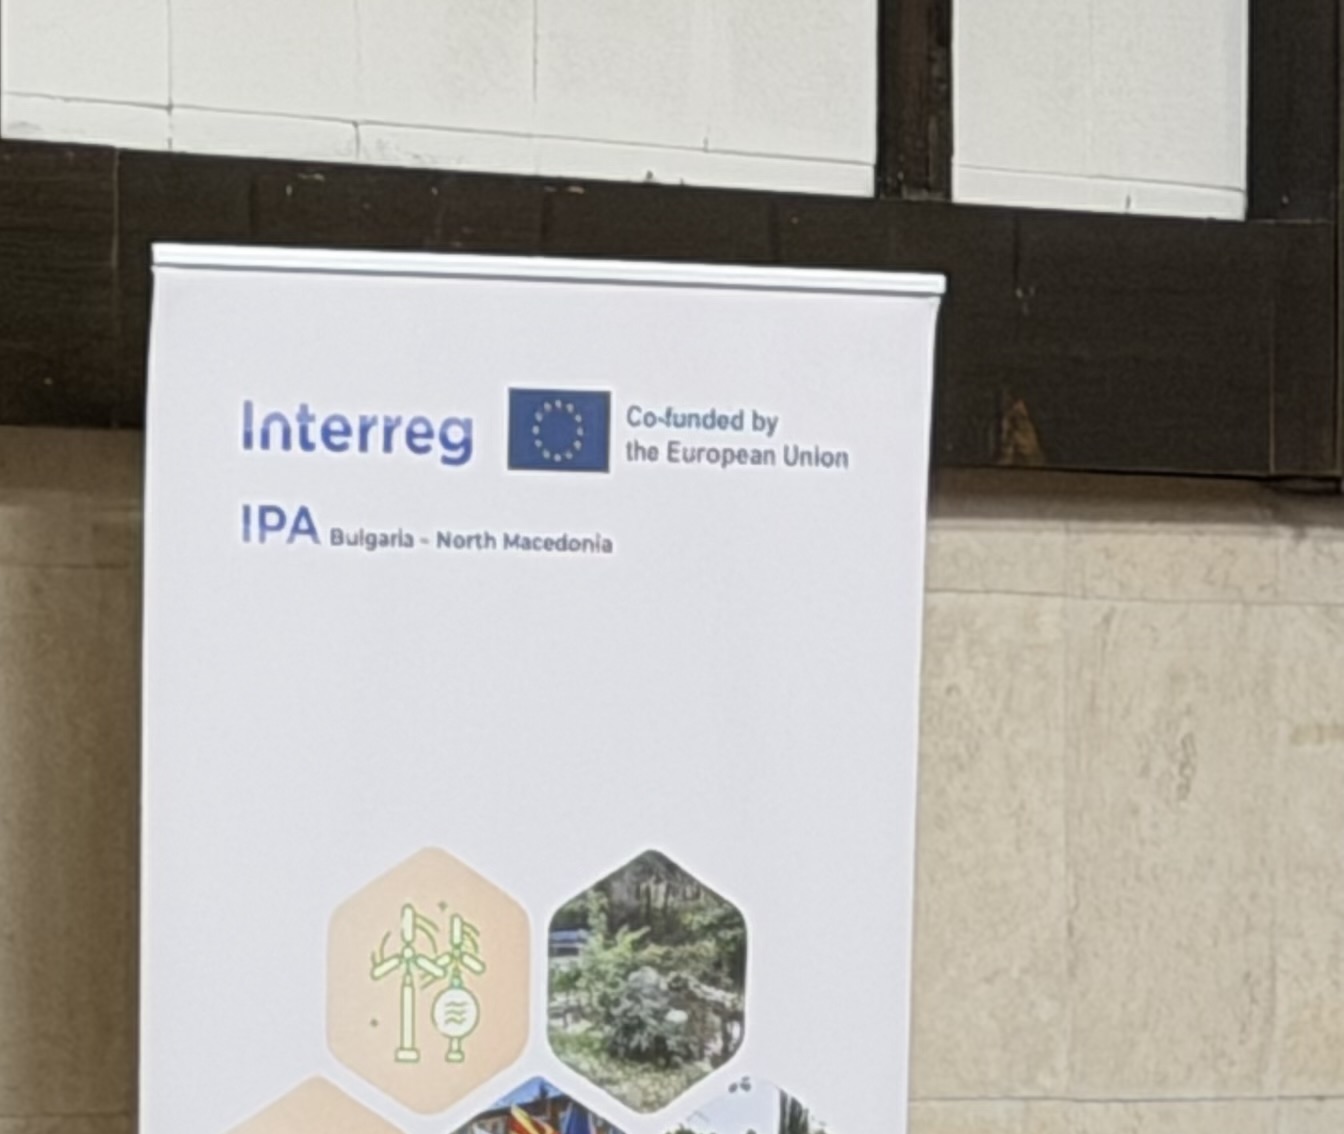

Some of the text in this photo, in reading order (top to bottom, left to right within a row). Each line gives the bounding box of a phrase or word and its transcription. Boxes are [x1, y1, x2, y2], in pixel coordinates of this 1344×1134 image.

[242, 399, 473, 467] Interreg
[626, 404, 779, 438] Co-funded by
[626, 439, 850, 469] the European Union
[242, 503, 321, 545] IPA
[330, 527, 414, 552] Bulgaria
[436, 529, 496, 551] North
[504, 531, 614, 554] Macedonia
